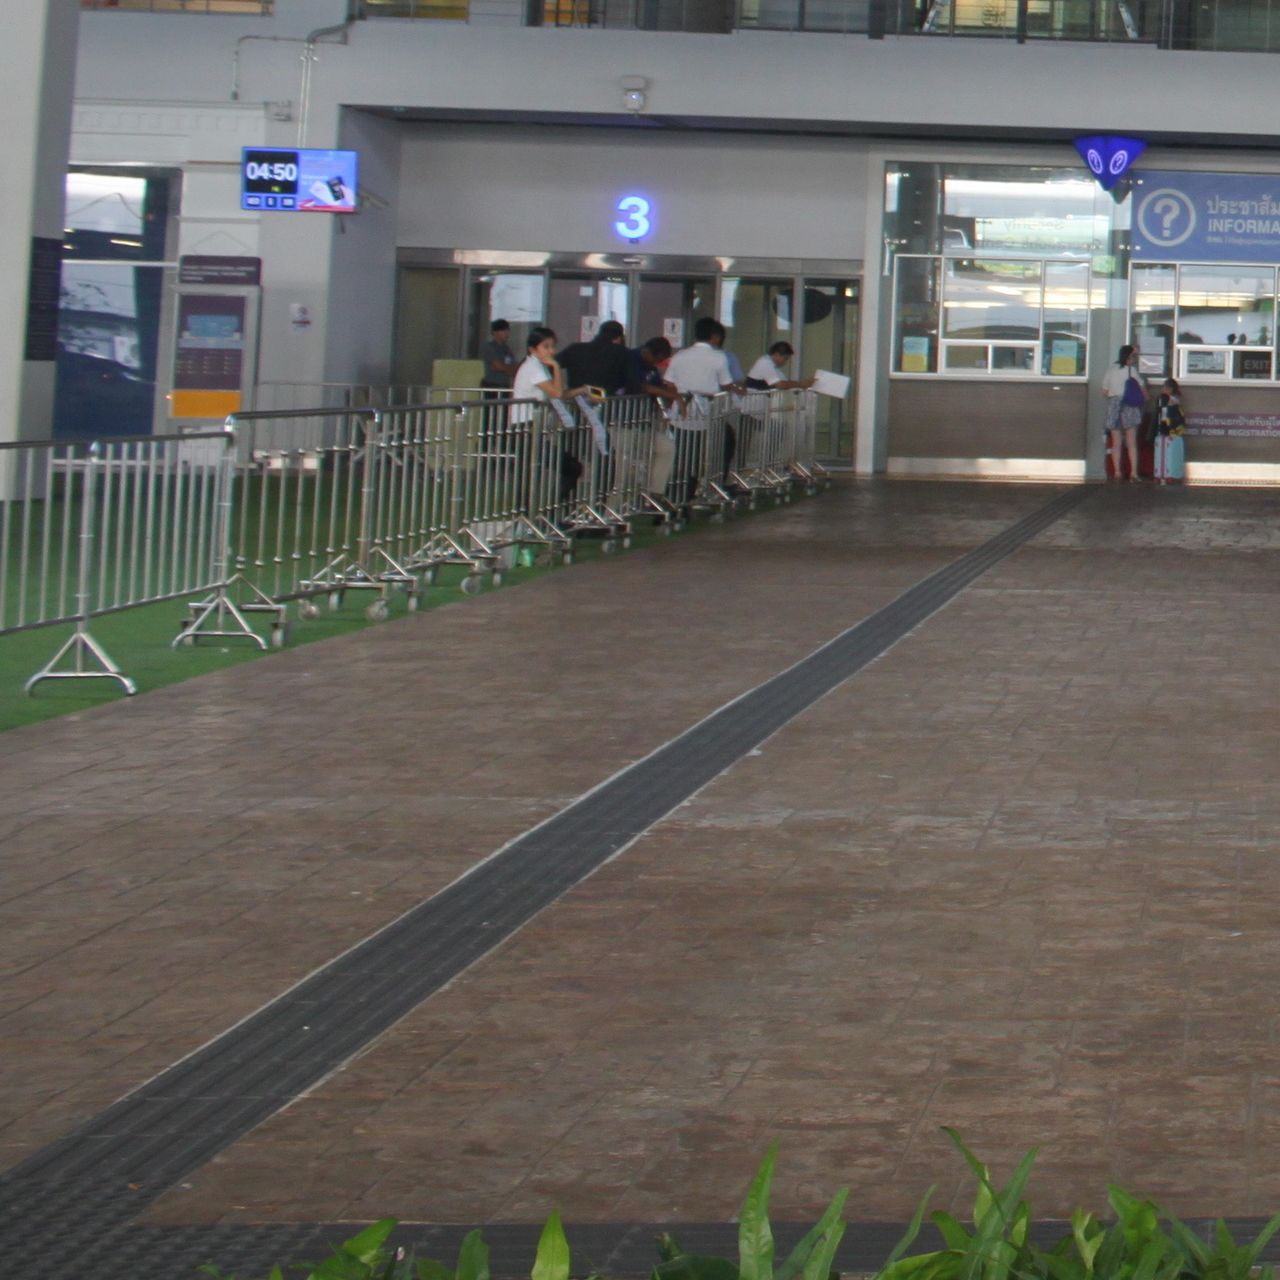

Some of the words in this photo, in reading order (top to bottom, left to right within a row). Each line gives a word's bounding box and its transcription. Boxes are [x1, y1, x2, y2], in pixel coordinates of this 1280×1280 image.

[246, 162, 297, 181] 04:50
[616, 196, 650, 239] 3
[1243, 360, 1271, 370] EXIT
